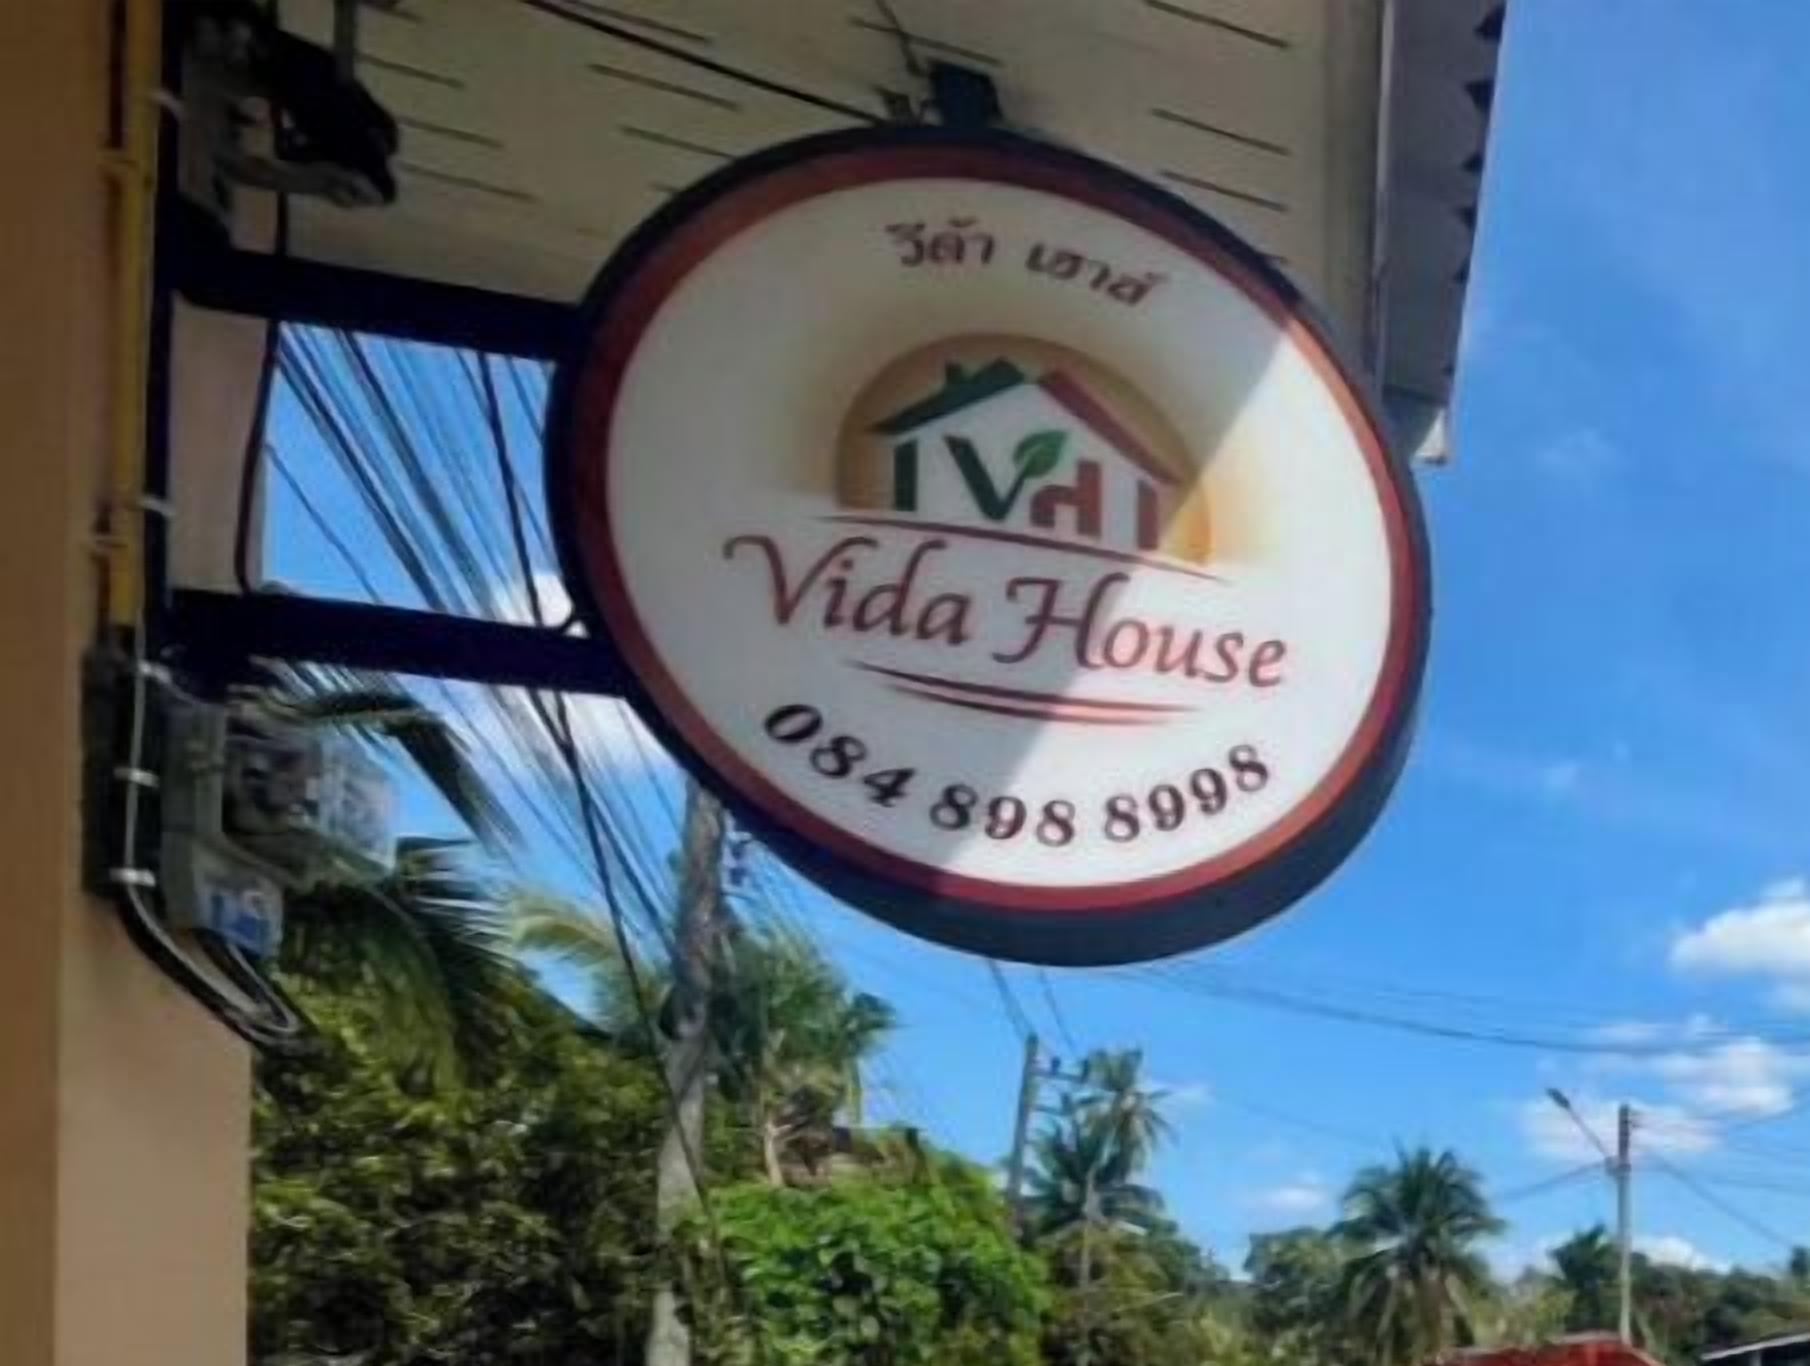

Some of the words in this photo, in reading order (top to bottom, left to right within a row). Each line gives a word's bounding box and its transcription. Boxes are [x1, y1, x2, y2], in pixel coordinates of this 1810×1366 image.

[723, 533, 974, 646] Vida
[992, 572, 1288, 688] House
[764, 702, 916, 808] 084
[929, 782, 1076, 846] 898
[1102, 742, 1271, 843] 8998
